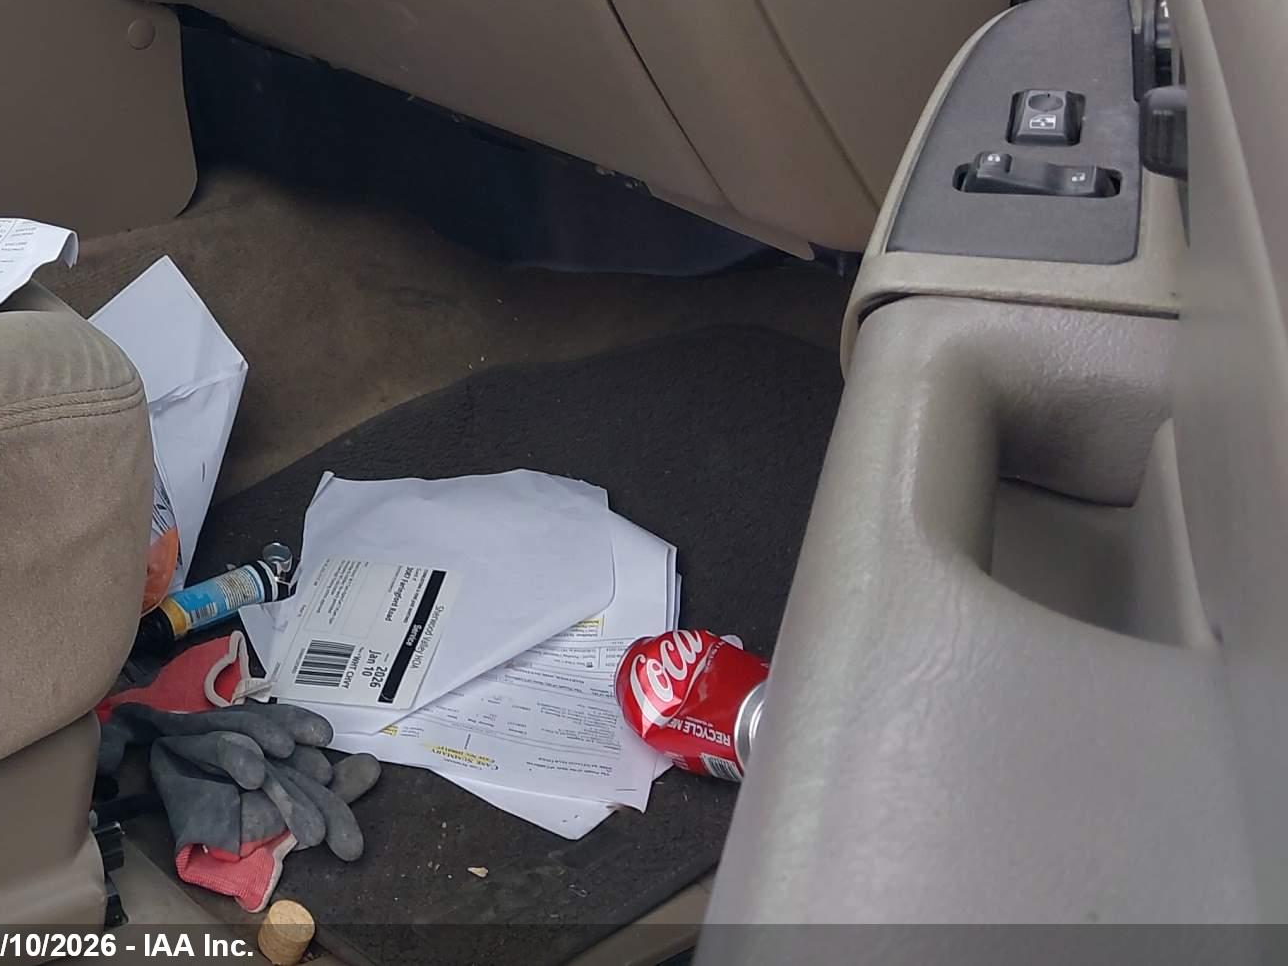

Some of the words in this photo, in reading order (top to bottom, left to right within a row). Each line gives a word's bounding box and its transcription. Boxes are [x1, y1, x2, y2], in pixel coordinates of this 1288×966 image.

[385, 607, 397, 622] Road
[425, 604, 444, 636] Sherwood
[405, 624, 423, 647] Service
[414, 635, 431, 655] Valley
[350, 656, 361, 670] WHT
[366, 649, 382, 664] Jan
[409, 654, 423, 669] HOA
[342, 671, 355, 689] CHVY
[362, 667, 374, 677] 10
[369, 666, 388, 688] 2026
[630, 630, 703, 727] Coca
[683, 720, 731, 747] RECYCLE
